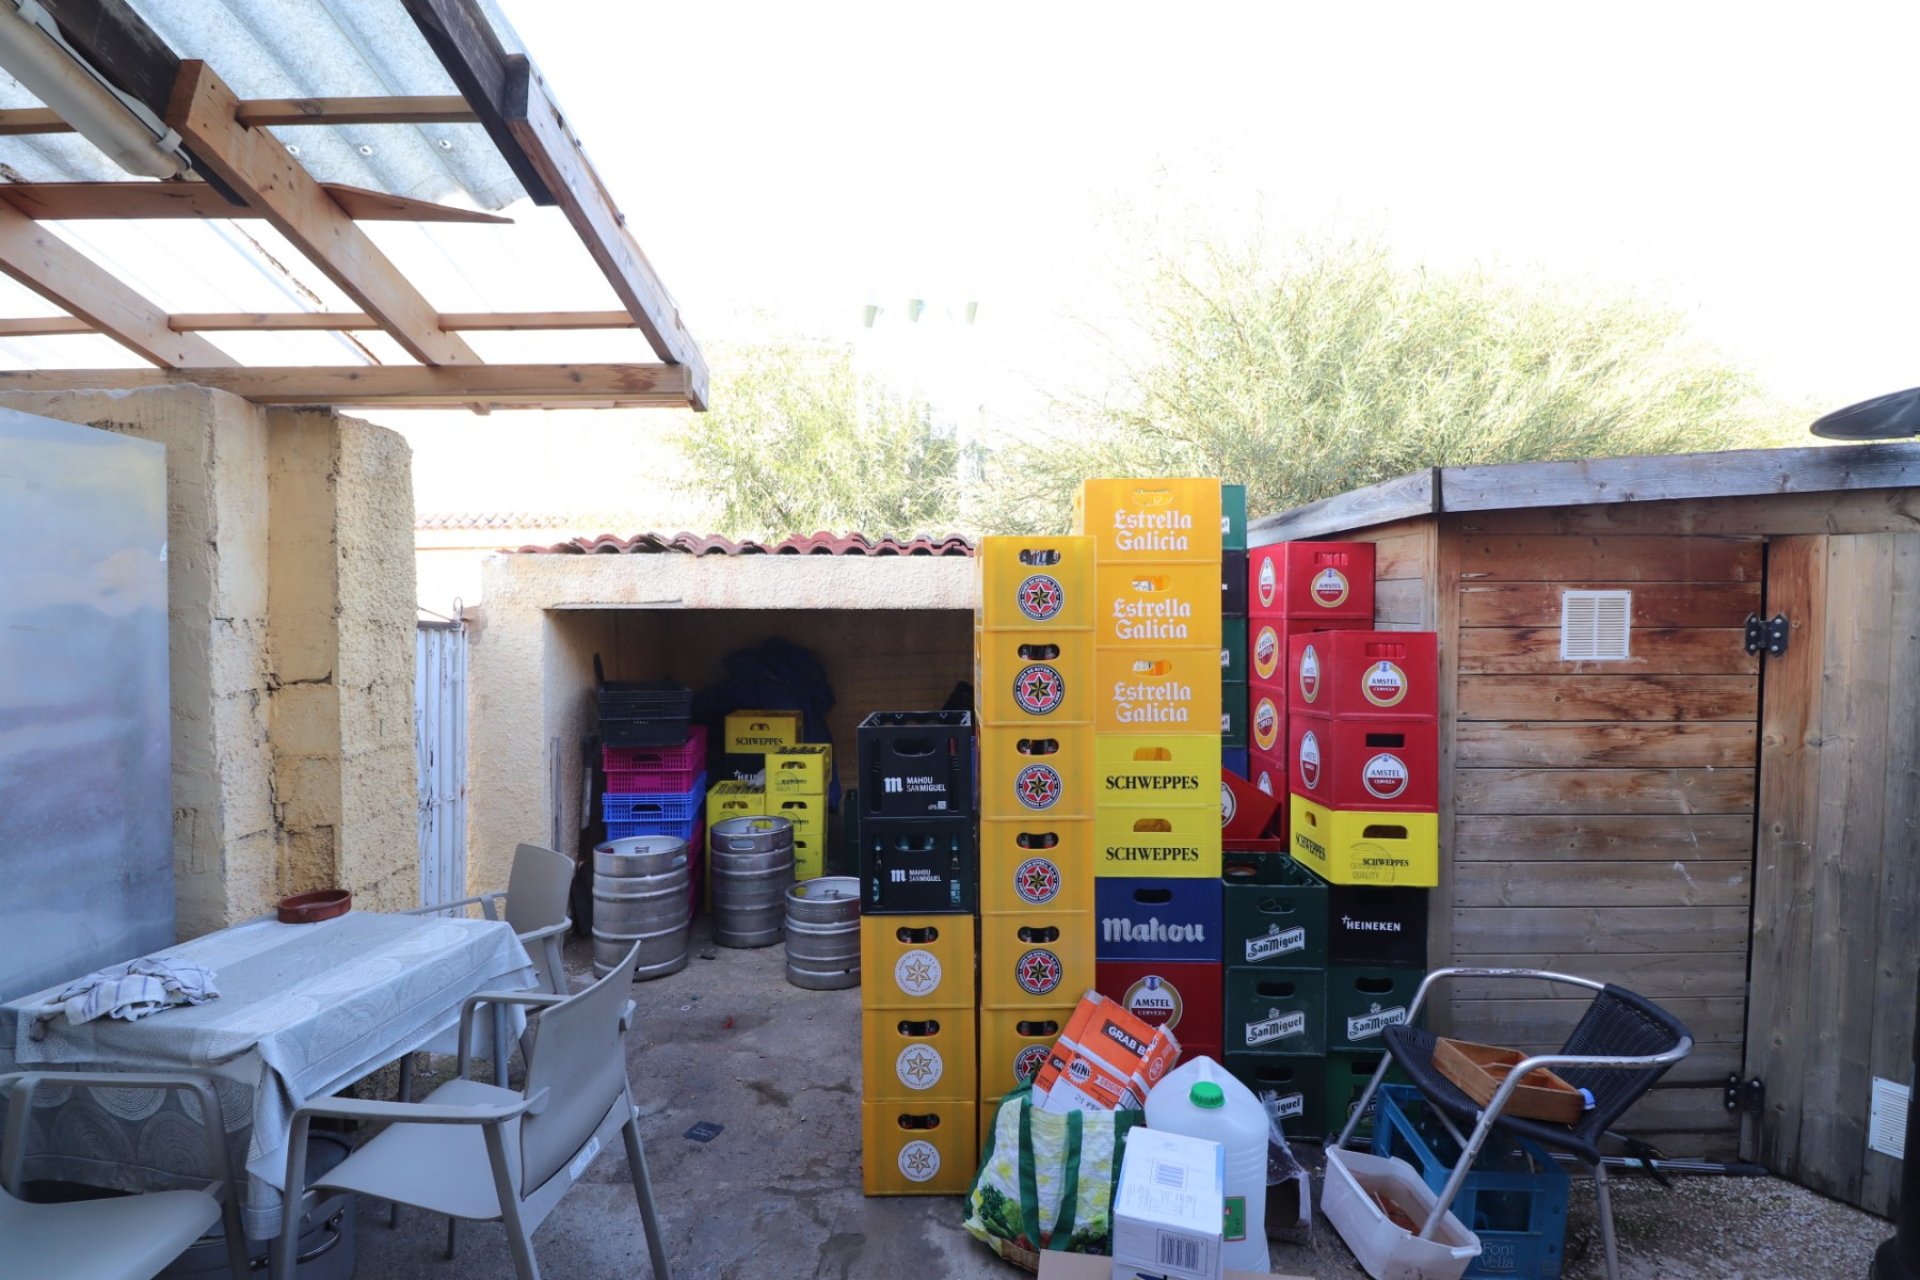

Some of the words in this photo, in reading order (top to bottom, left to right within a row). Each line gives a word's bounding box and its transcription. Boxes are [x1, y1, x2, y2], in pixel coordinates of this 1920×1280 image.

[1113, 508, 1192, 529] Estrella
[1116, 530, 1189, 551] Galicia
[1113, 598, 1191, 618] Estrella
[1115, 618, 1188, 640] Galicia
[1113, 681, 1192, 701] Estrella
[1115, 702, 1188, 723] Galicia
[906, 776, 933, 784] MAHOU
[1105, 775, 1199, 790] SCHWEPPES
[1370, 769, 1400, 777] AMSTEL
[1105, 846, 1199, 861] SCHWEPPES
[1362, 857, 1409, 867] SCHWEPPES
[1102, 916, 1206, 943] Mahou
[1346, 920, 1402, 931] HEINEKEN
[1135, 998, 1170, 1007] AMSTEL
[1108, 1025, 1137, 1050] GRAB
[1277, 1096, 1301, 1114] iguel
